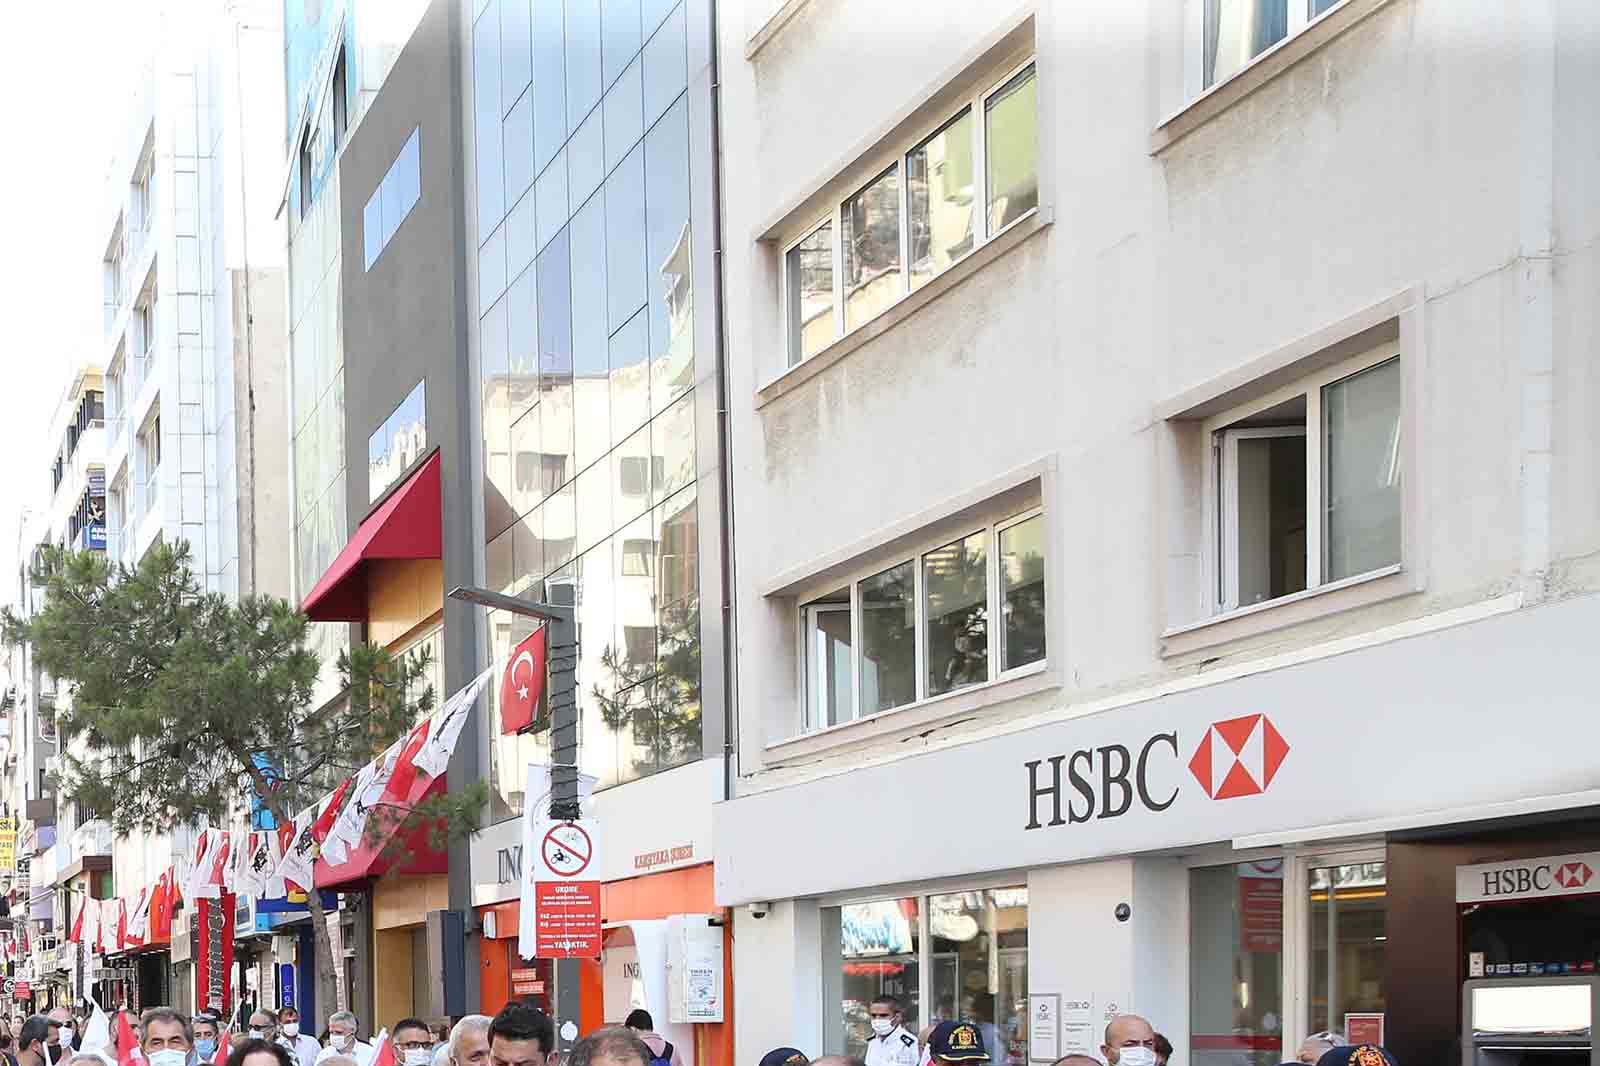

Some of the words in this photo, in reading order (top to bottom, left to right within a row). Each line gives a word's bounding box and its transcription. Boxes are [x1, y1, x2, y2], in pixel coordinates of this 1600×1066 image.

[1024, 730, 1180, 831] HSBC
[1482, 865, 1552, 896] HSBC
[623, 962, 640, 978] ING
